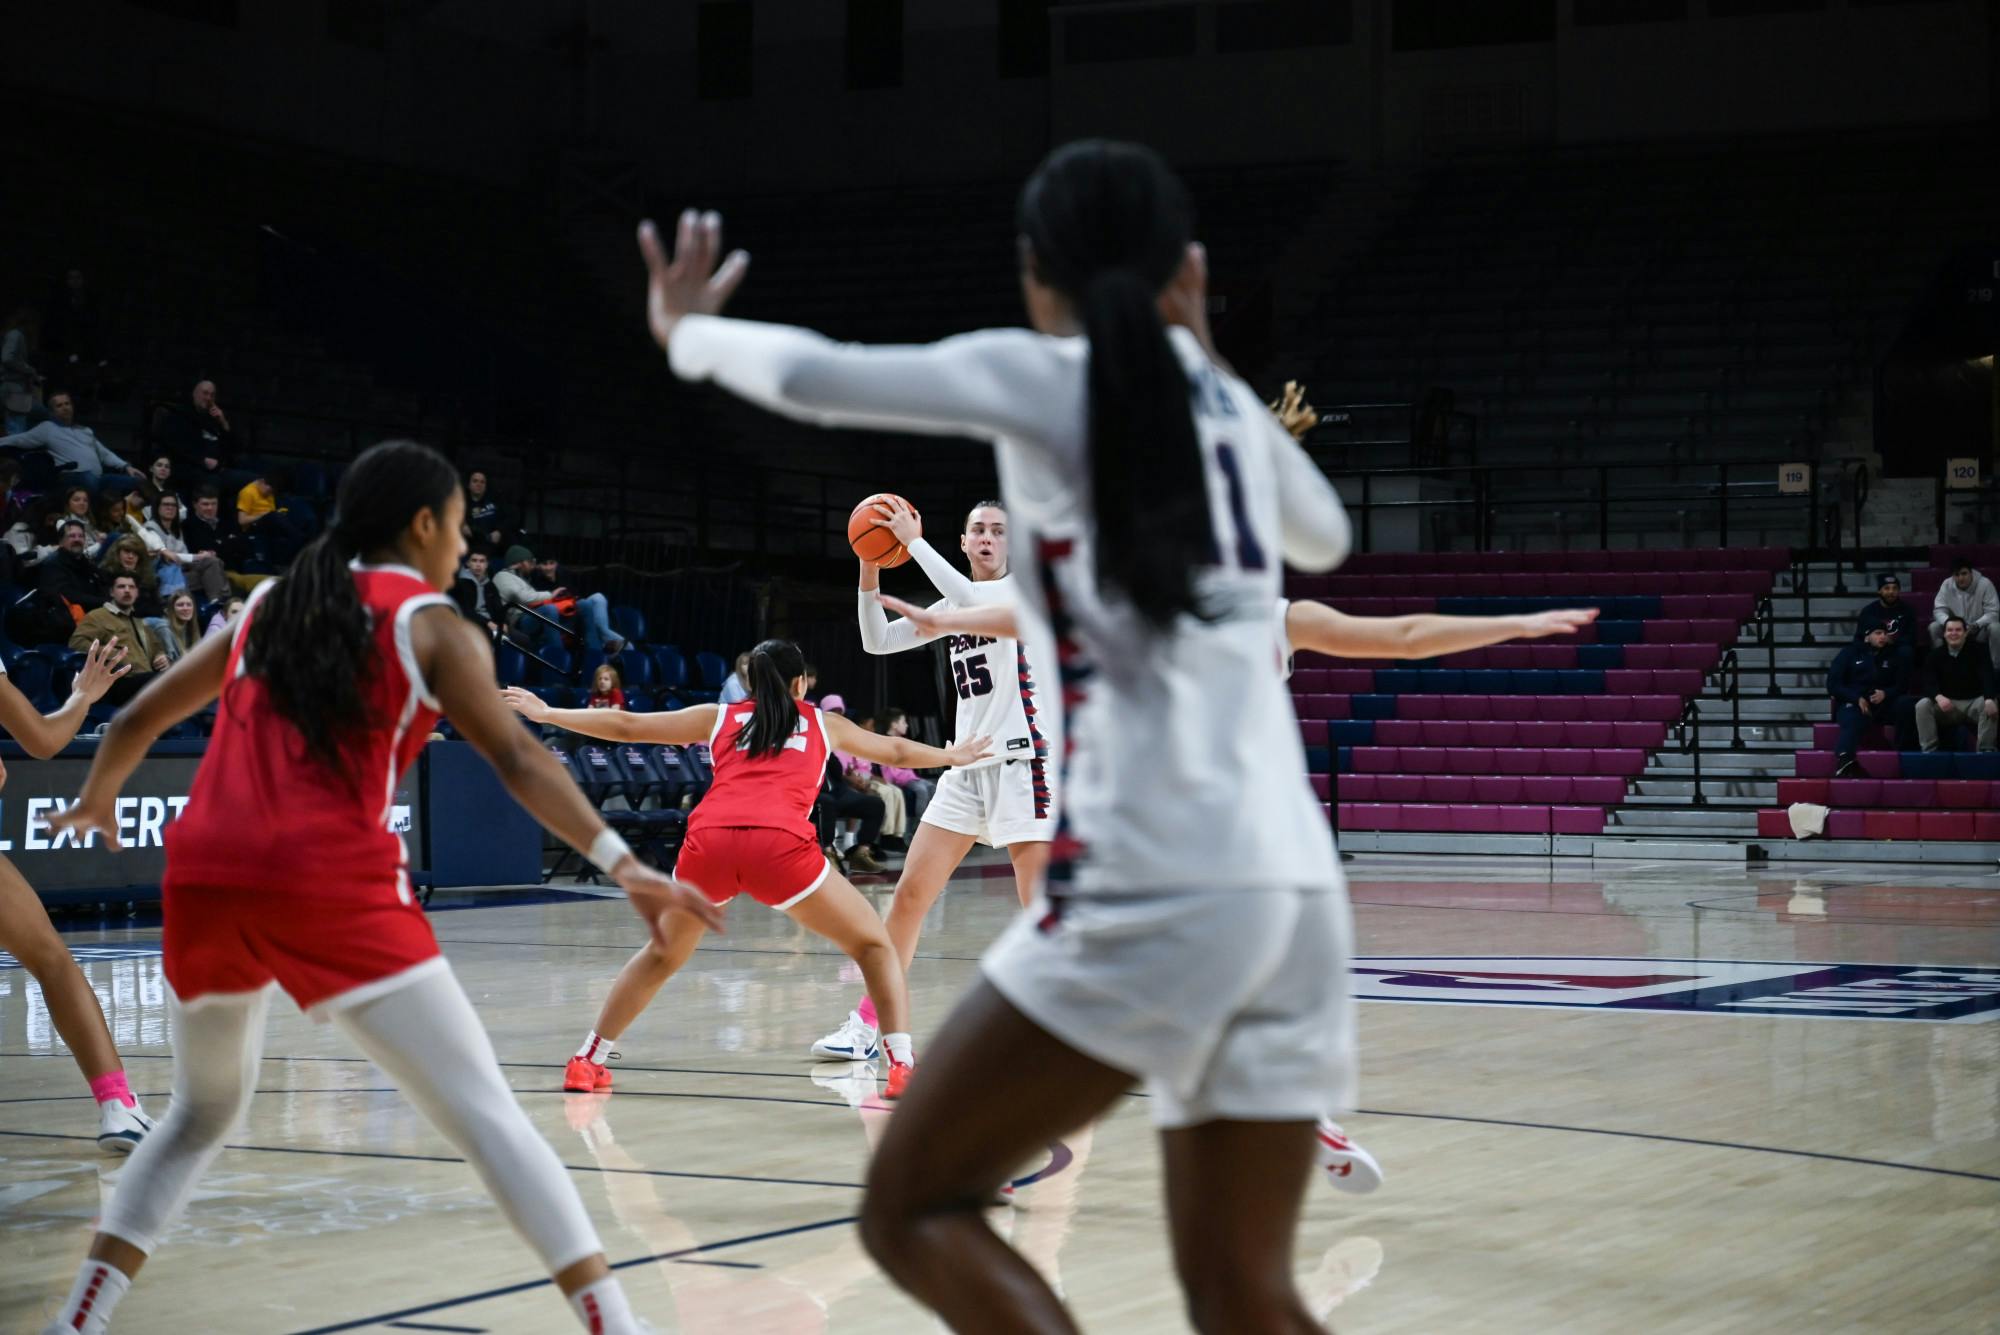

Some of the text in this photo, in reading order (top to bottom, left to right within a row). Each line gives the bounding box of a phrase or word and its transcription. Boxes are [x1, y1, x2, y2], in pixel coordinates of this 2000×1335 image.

[1785, 471, 1803, 482] 119
[1953, 465, 1976, 479] 120
[953, 653, 993, 700] 25
